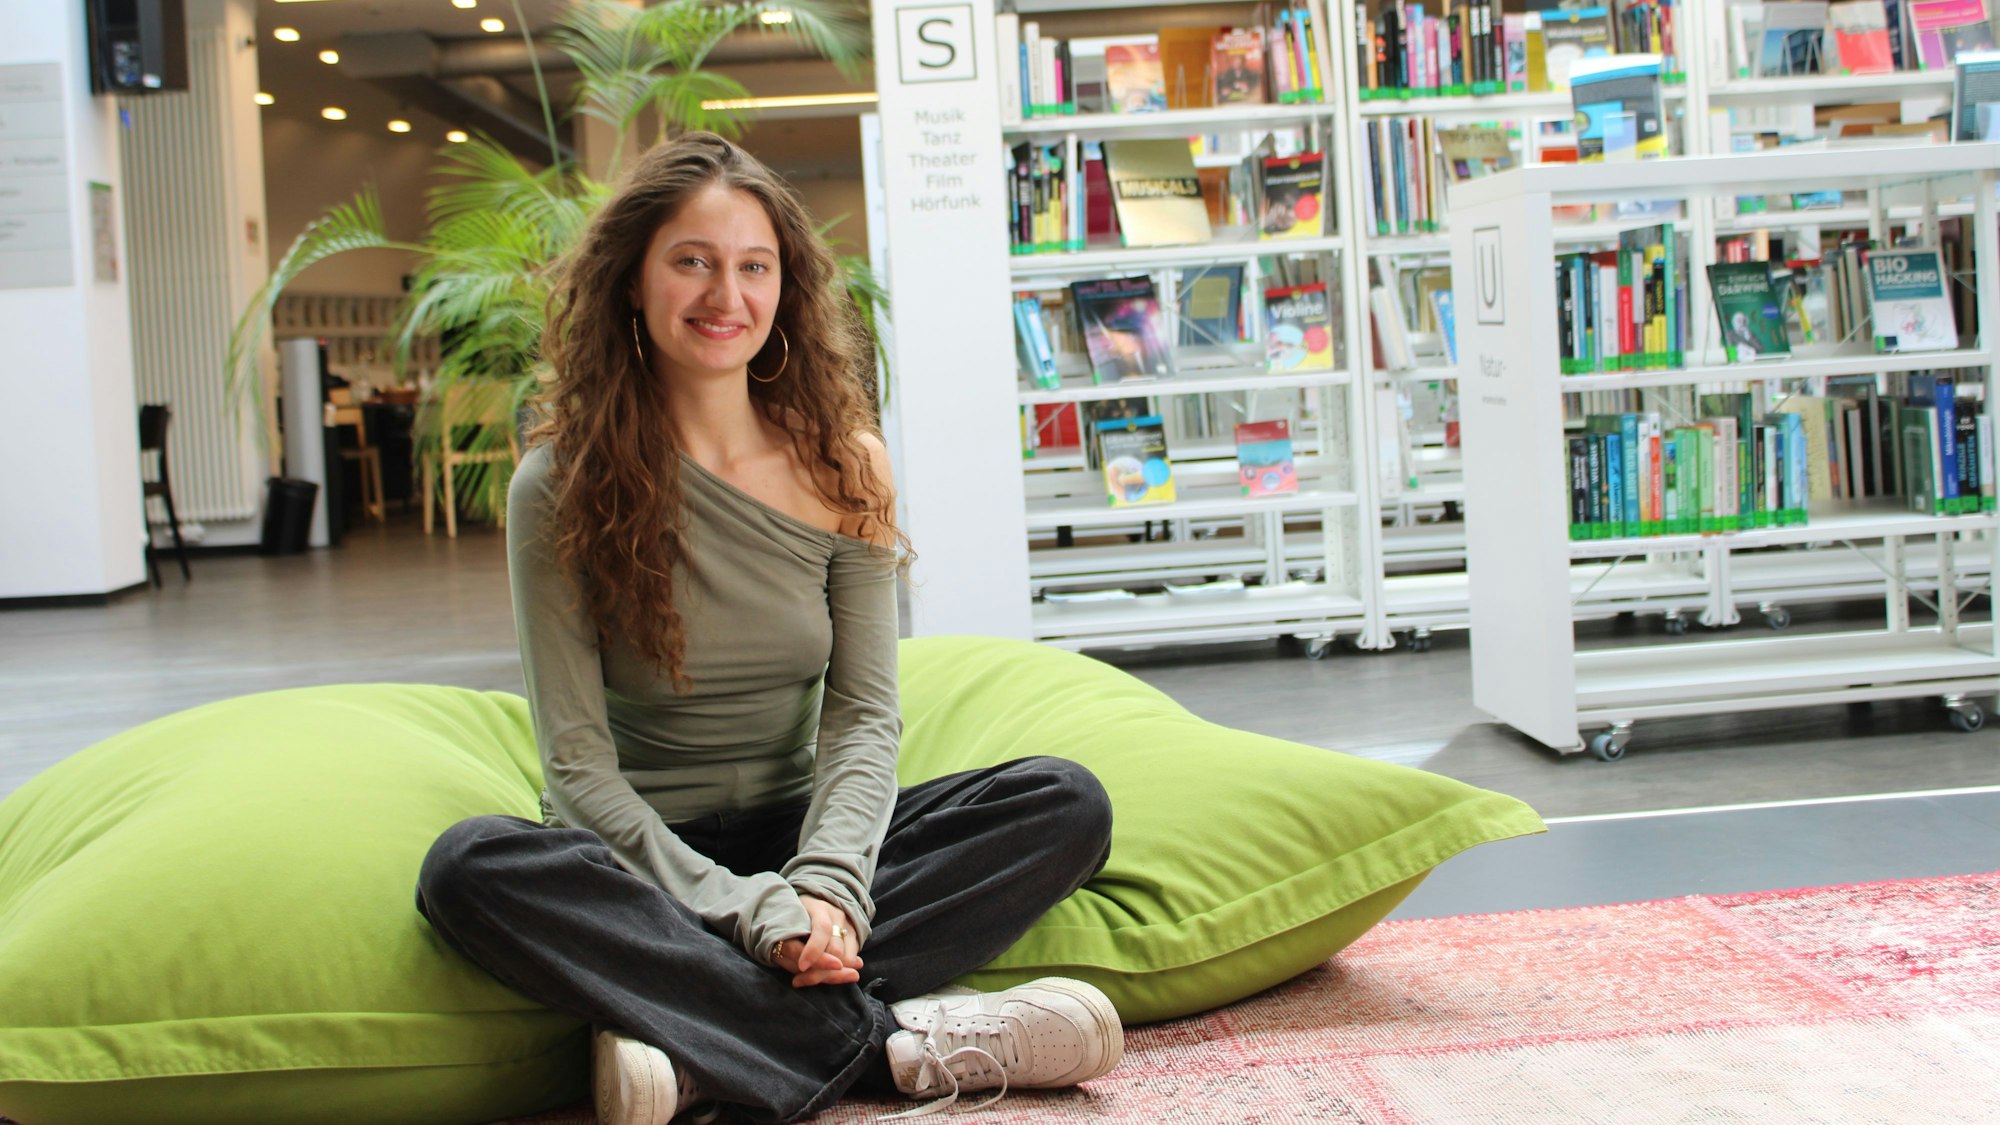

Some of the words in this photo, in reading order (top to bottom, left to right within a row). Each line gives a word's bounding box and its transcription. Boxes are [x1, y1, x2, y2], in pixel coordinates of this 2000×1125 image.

[917, 18, 957, 69] S
[914, 108, 966, 125] Musik
[921, 130, 962, 146] Tanz
[909, 151, 977, 169] Theater
[926, 172, 964, 190] Film
[1119, 179, 1198, 197] MUSICALS
[911, 193, 982, 213] Hörfunk
[1873, 255, 1908, 273] BIO
[1479, 243, 1497, 310] U
[1876, 269, 1938, 287] HACKING
[1270, 301, 1324, 319] Violine
